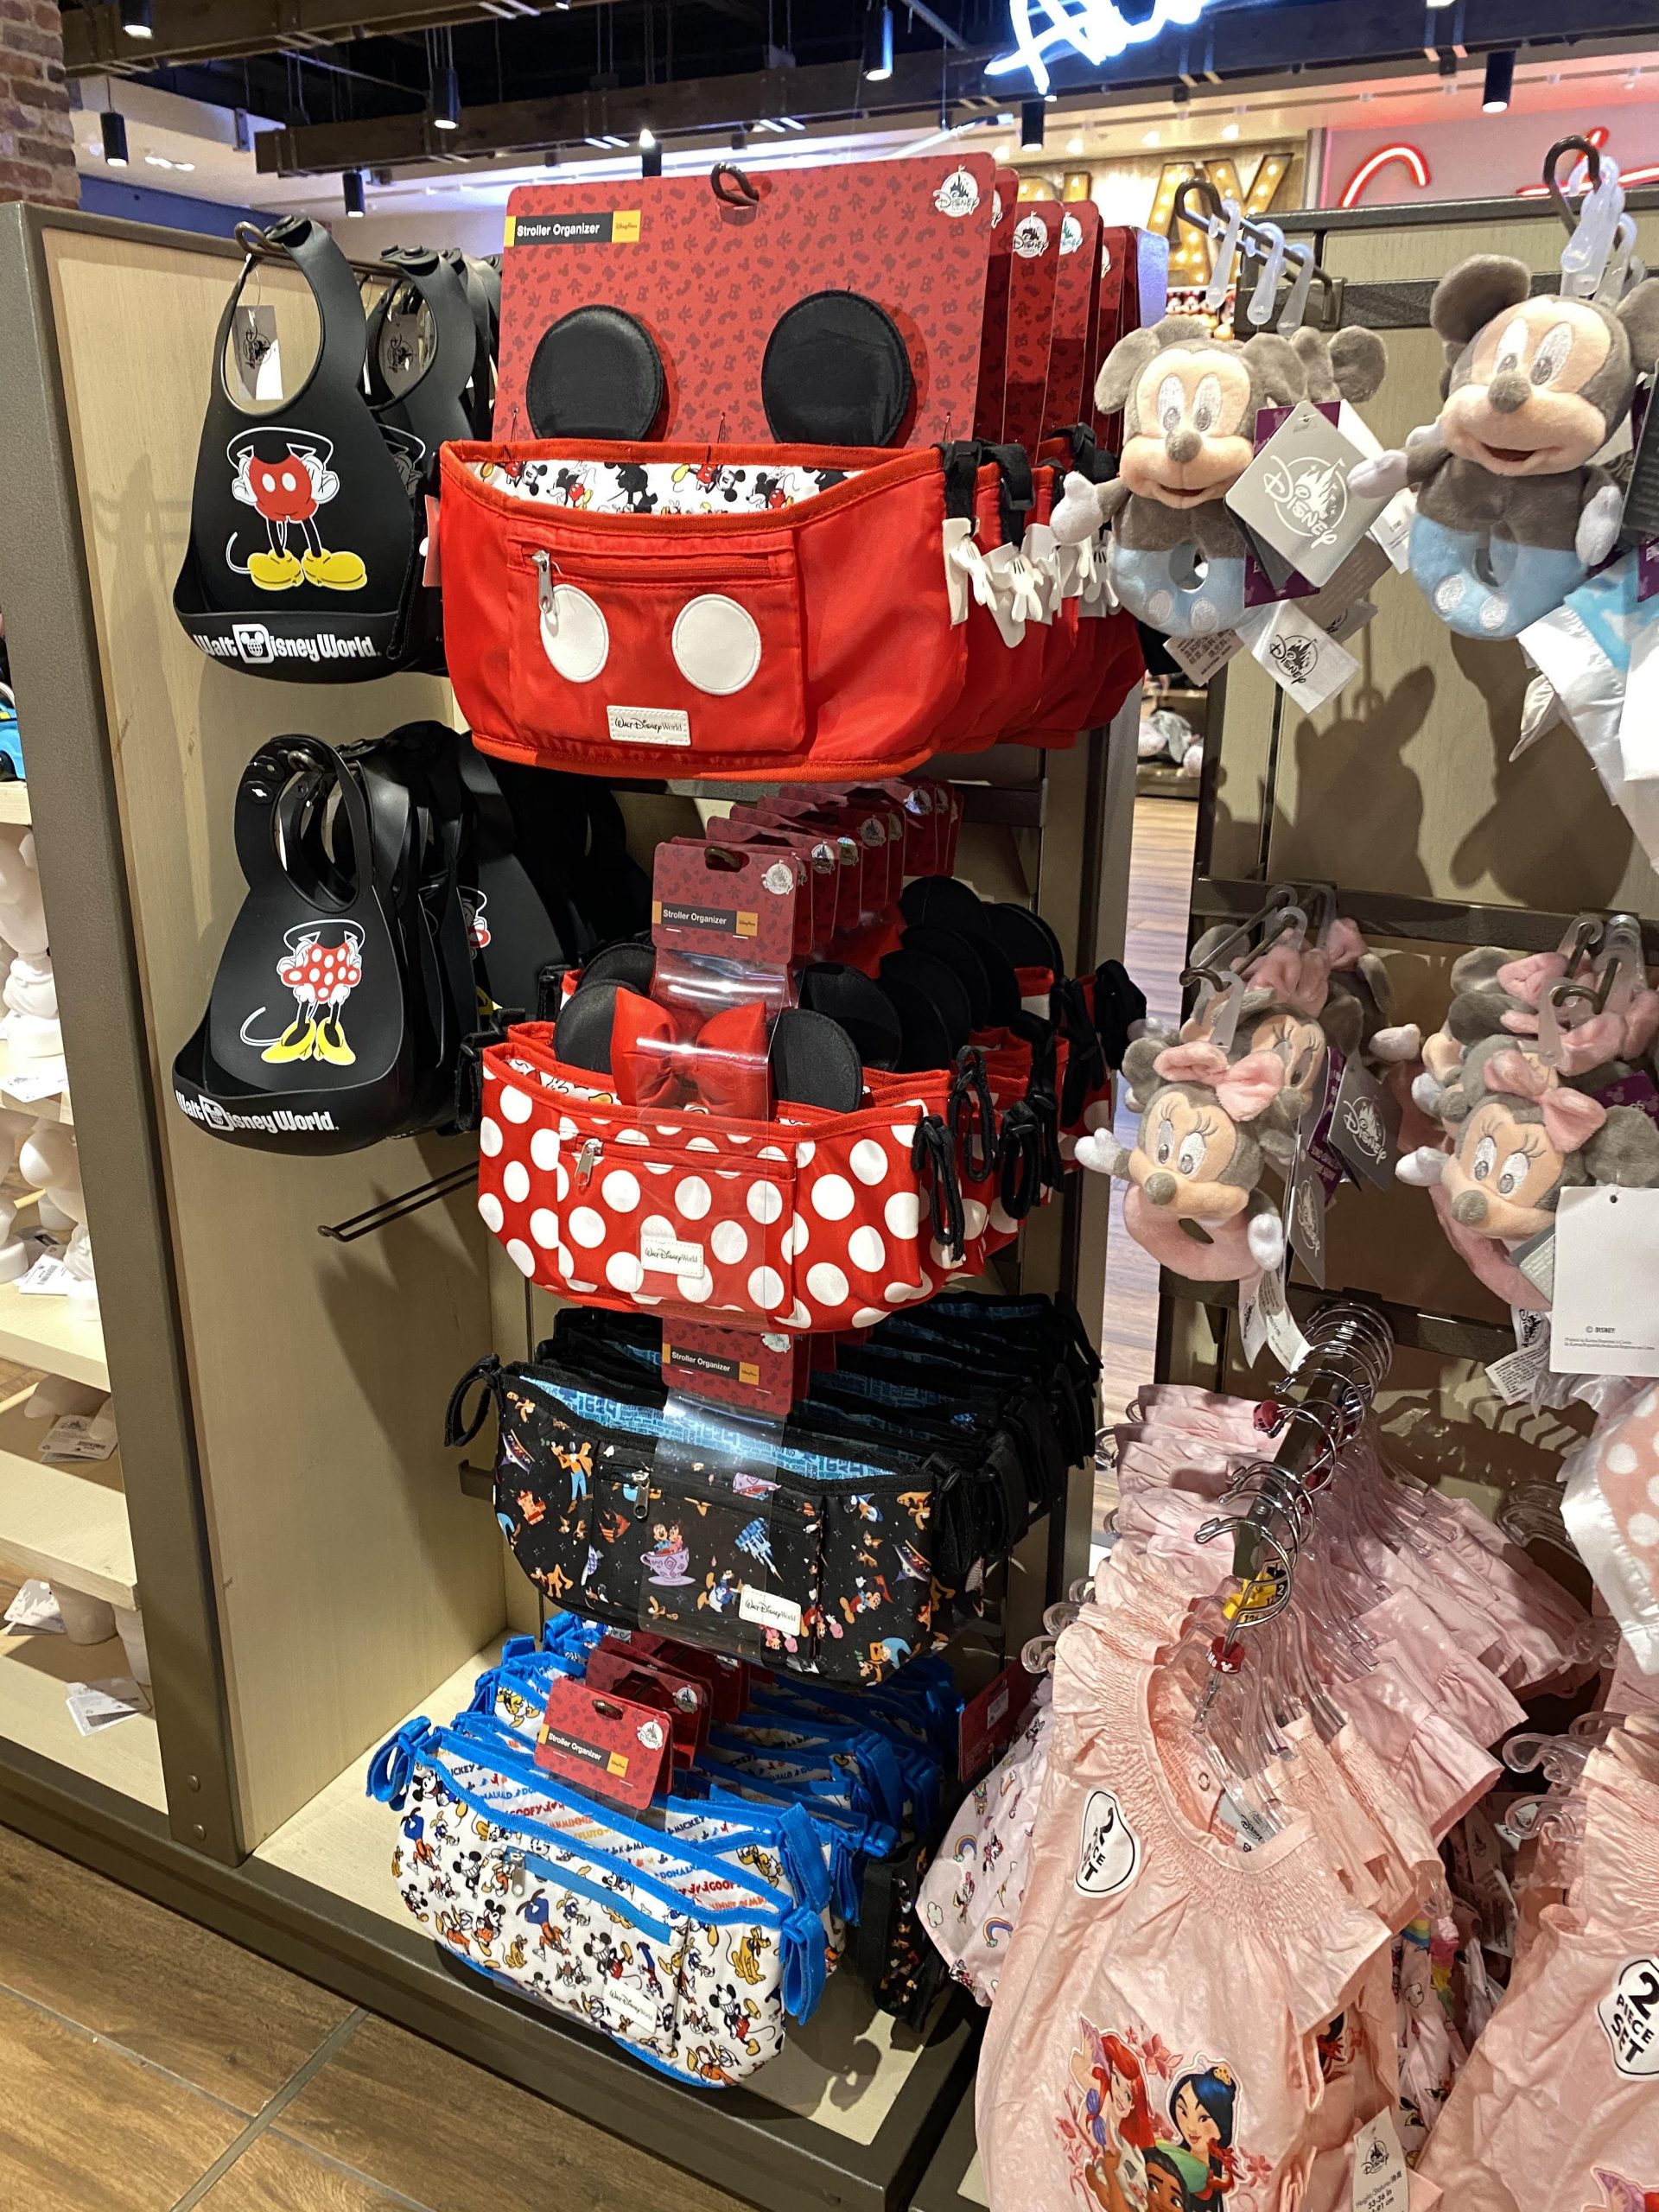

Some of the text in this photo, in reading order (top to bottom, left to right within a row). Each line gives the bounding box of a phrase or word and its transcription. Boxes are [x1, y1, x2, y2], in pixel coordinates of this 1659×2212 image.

[517, 225, 551, 237] Stroller
[552, 222, 600, 238] Organizer
[1263, 454, 1338, 550] Disney
[194, 623, 378, 664] Walt Disney World
[1269, 634, 1306, 685] Disney
[614, 715, 683, 734] Walt Disney World
[663, 909, 690, 920] Stroller
[690, 912, 728, 925] Organizer
[175, 1090, 335, 1135] Walt Disney World
[1343, 1100, 1387, 1165] Disney
[645, 1247, 698, 1264] Walt Disney World
[671, 1351, 731, 1372] Stroller Organizer
[745, 1599, 760, 1611] Walt
[759, 1601, 782, 1620] Disney
[548, 1732, 602, 1761] Stroller Organizer
[609, 1989, 622, 2002] Walt
[1628, 1971, 1659, 2020] 2
[1616, 1993, 1655, 2044] PIECE
[1611, 2012, 1645, 2063] SET
